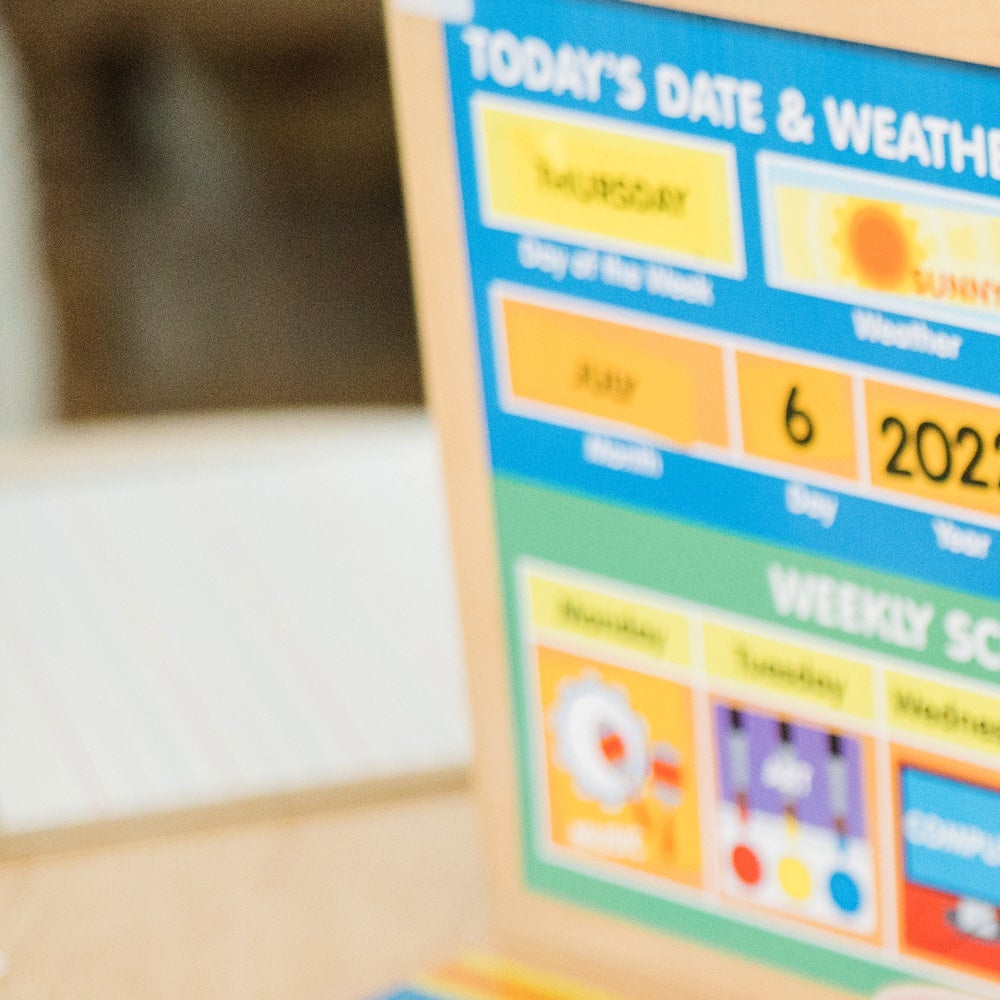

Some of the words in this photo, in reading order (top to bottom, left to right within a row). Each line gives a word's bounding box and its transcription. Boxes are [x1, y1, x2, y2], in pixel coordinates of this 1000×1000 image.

[460, 27, 646, 111] TODAY'S
[656, 64, 766, 135] DATE
[776, 87, 815, 145] &
[784, 385, 815, 448] 6
[767, 563, 935, 651] WEEKLY
